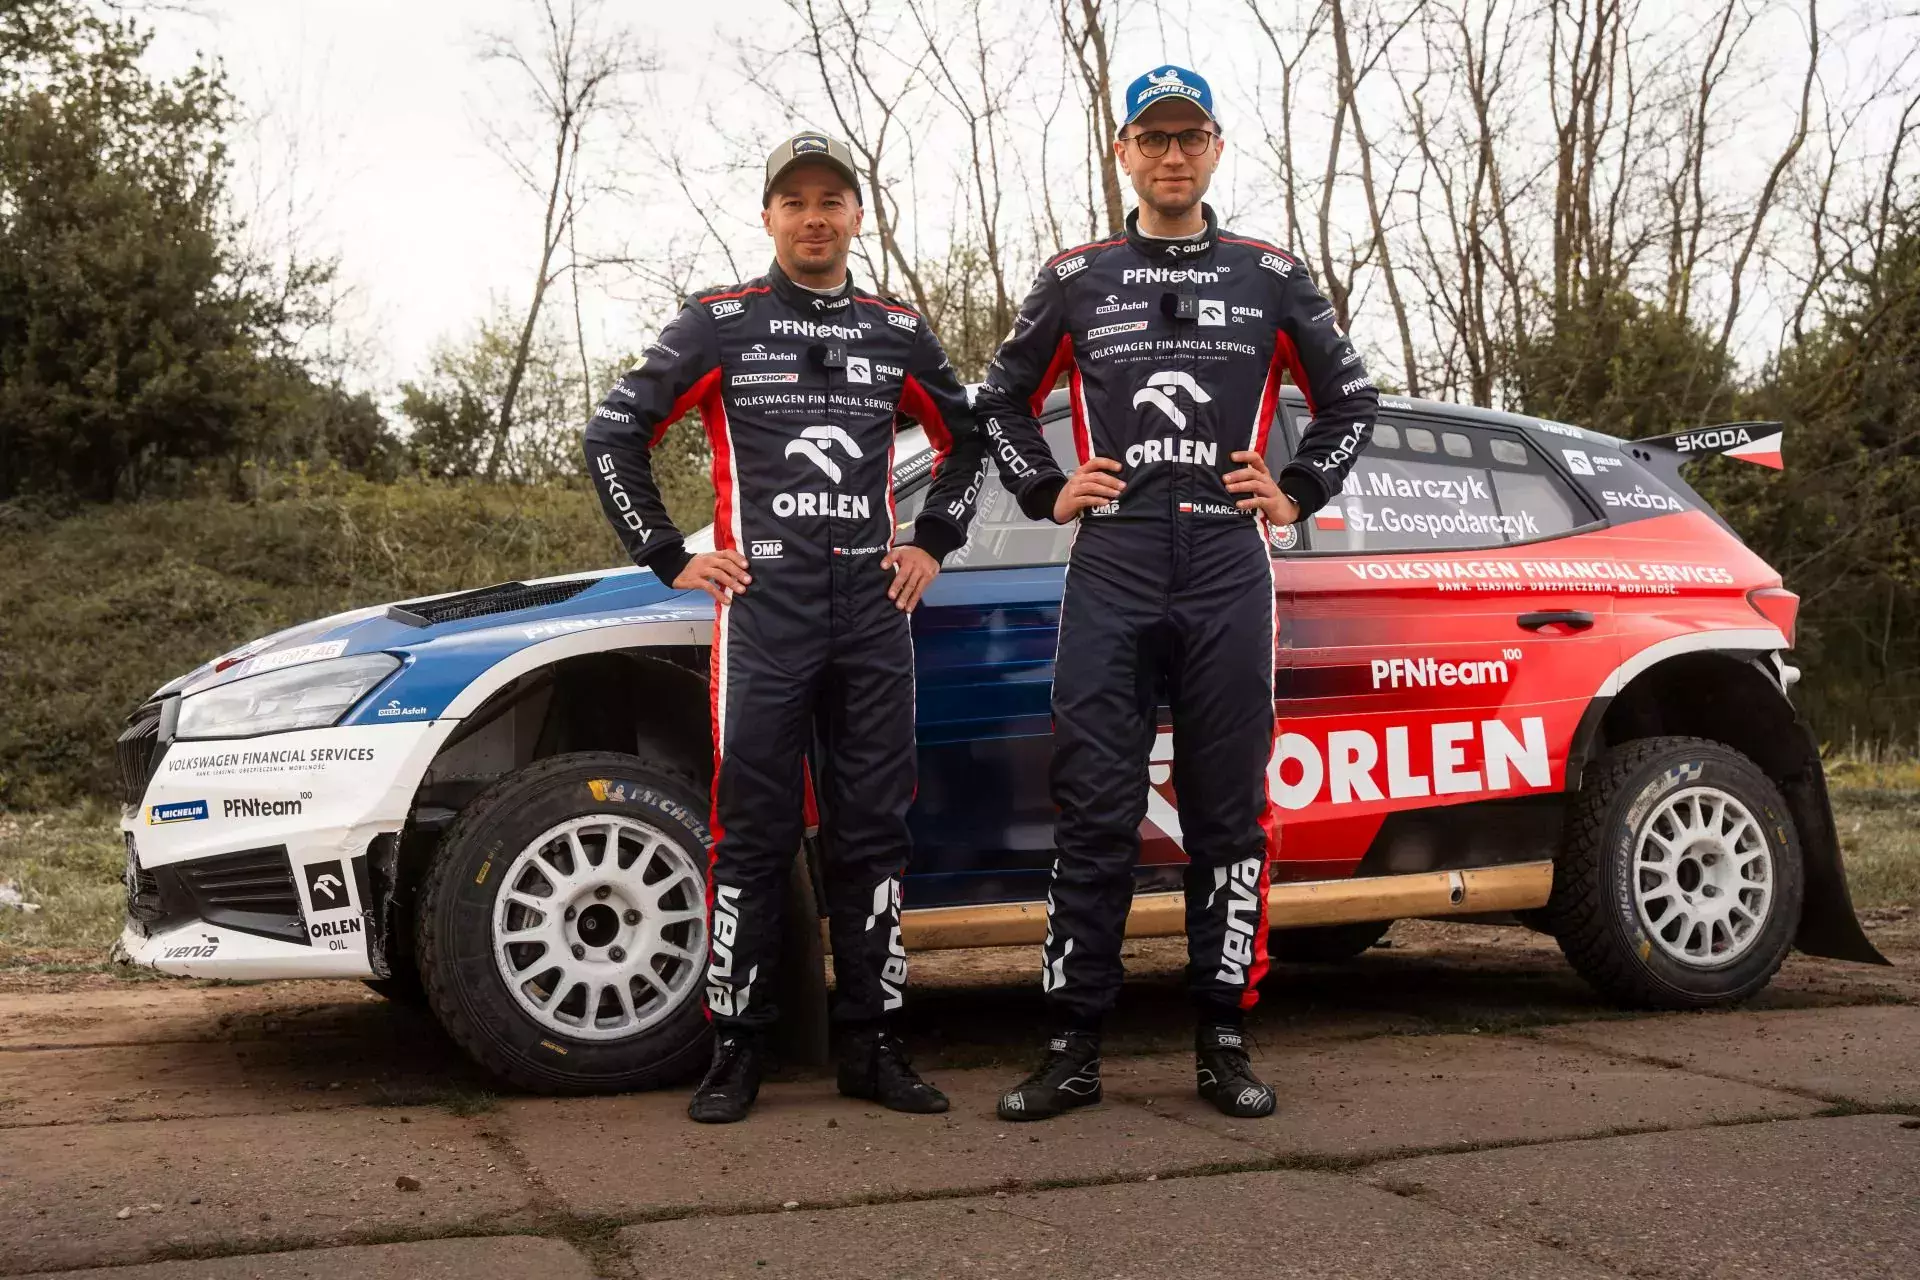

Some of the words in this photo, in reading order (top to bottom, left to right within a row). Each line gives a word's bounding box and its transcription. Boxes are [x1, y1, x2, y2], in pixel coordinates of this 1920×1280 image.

[1137, 85, 1202, 104] MICHELIN
[1183, 241, 1210, 253] ORLEN
[1057, 257, 1086, 276] OMP
[1261, 255, 1292, 274] OMP
[712, 302, 742, 315] OMP
[827, 298, 850, 308] ORLEN
[1097, 305, 1119, 313] ORLEN
[1121, 301, 1148, 310] Asfalt
[1232, 306, 1263, 318] ORLEN
[887, 314, 918, 328] OMP
[1232, 316, 1245, 324] OIL
[1090, 341, 1152, 360] VOLKSWAGEN
[1156, 340, 1213, 350] FINANCIAL
[1215, 341, 1256, 355] SERVICES
[743, 353, 767, 361] ORLEN
[769, 353, 797, 361] Asfalt
[875, 364, 904, 377] ORLEN
[876, 374, 888, 382] OIL
[734, 394, 805, 407] VOLKSWAGEN
[808, 394, 862, 406] FINANCIAL
[864, 398, 894, 411] SERVICES
[1383, 400, 1413, 410] Asfalt
[1539, 423, 1584, 440] verva
[1125, 437, 1217, 468] ORLEN
[1593, 455, 1623, 467] ORLEN
[772, 492, 870, 519] ORLEN
[1193, 503, 1204, 513] M.
[751, 543, 783, 556] OMP
[1346, 562, 1520, 580] VOLKSWAGEN
[1521, 562, 1640, 580] FINANCIAL
[1638, 563, 1734, 584] SERVICES
[1436, 582, 1472, 591] BANK.
[1477, 582, 1525, 591] LEASING.
[401, 707, 427, 715] Asfalt
[169, 753, 239, 772] VOLKSWAGEN
[242, 750, 306, 765] FINANCIAL
[310, 748, 374, 762] SERVICES
[1268, 716, 1552, 811] ORLEN
[161, 805, 203, 820] MICHELIN
[1215, 857, 1261, 985] verva
[311, 918, 361, 938] ORLEN
[164, 945, 219, 958] verva
[329, 940, 348, 951] OIL
[705, 884, 742, 1016] verva
[1218, 1036, 1242, 1045] OMP
